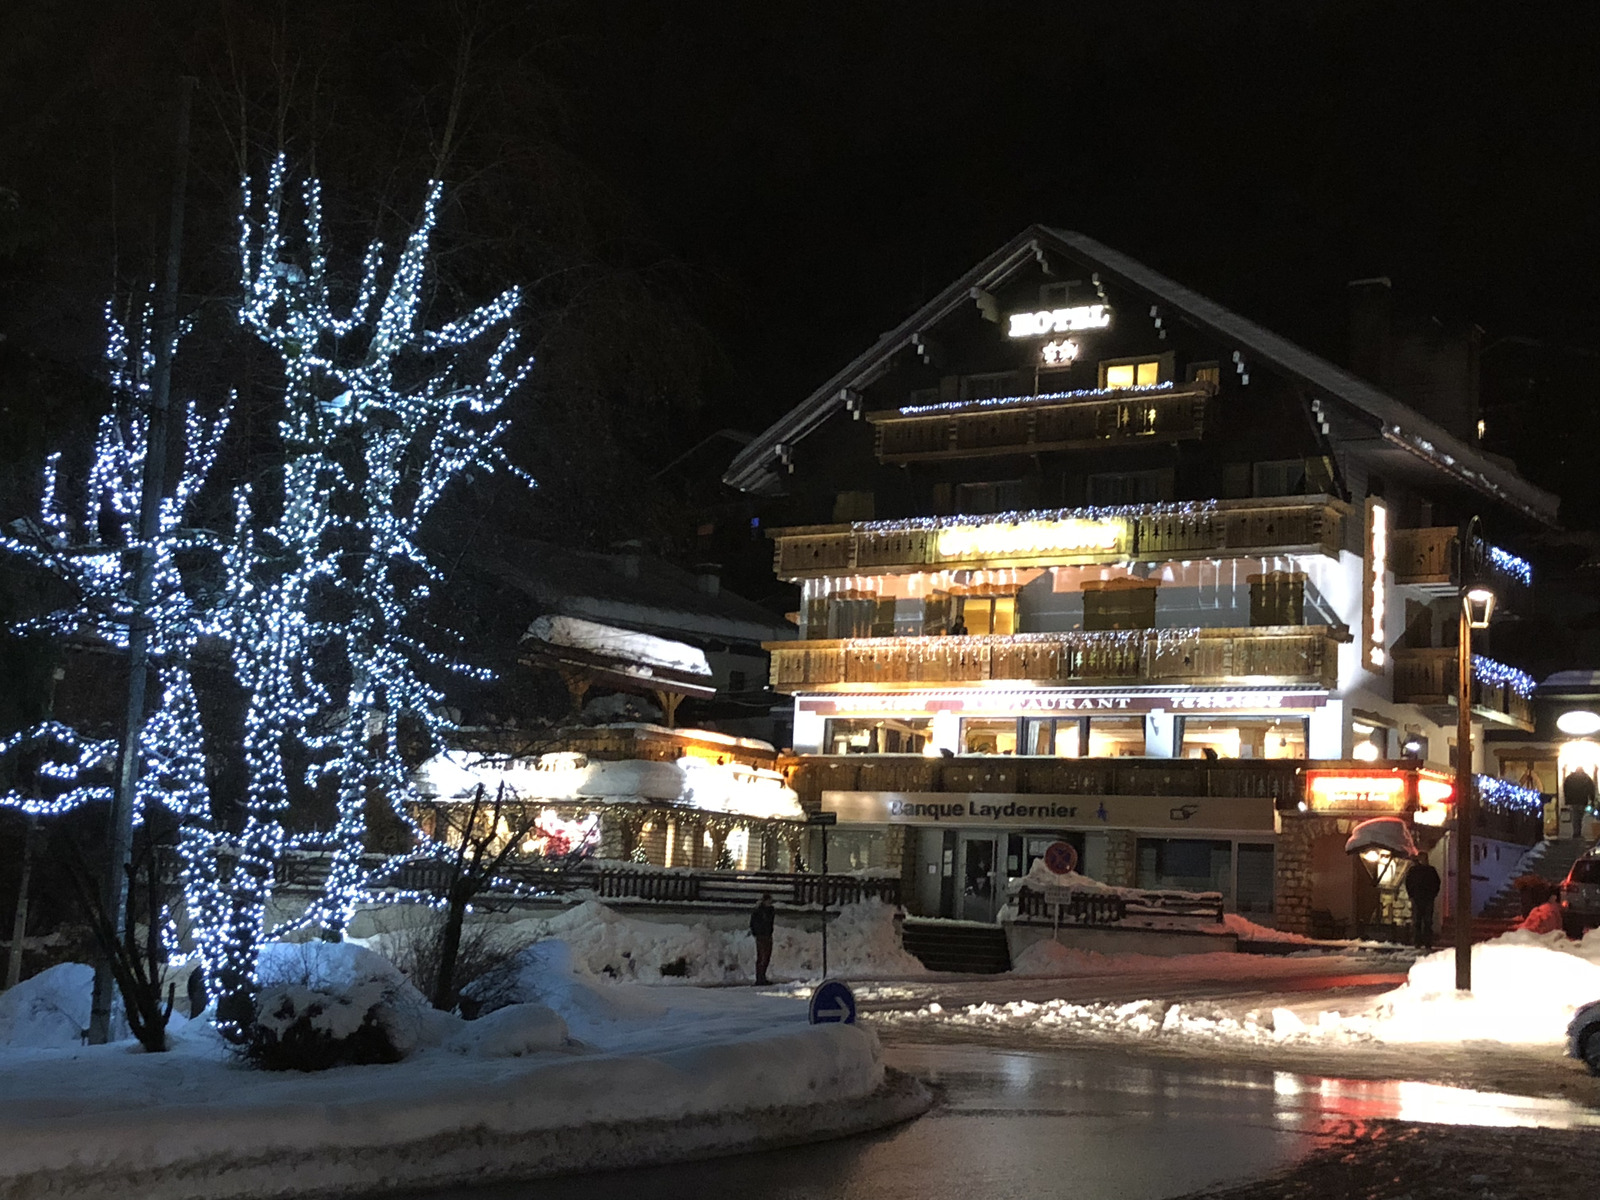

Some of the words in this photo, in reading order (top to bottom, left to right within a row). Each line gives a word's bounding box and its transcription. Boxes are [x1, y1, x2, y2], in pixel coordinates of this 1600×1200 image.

[962, 697, 1131, 711] TAURANT
[891, 800, 963, 820] Banque
[969, 801, 1077, 820] Laydernier
